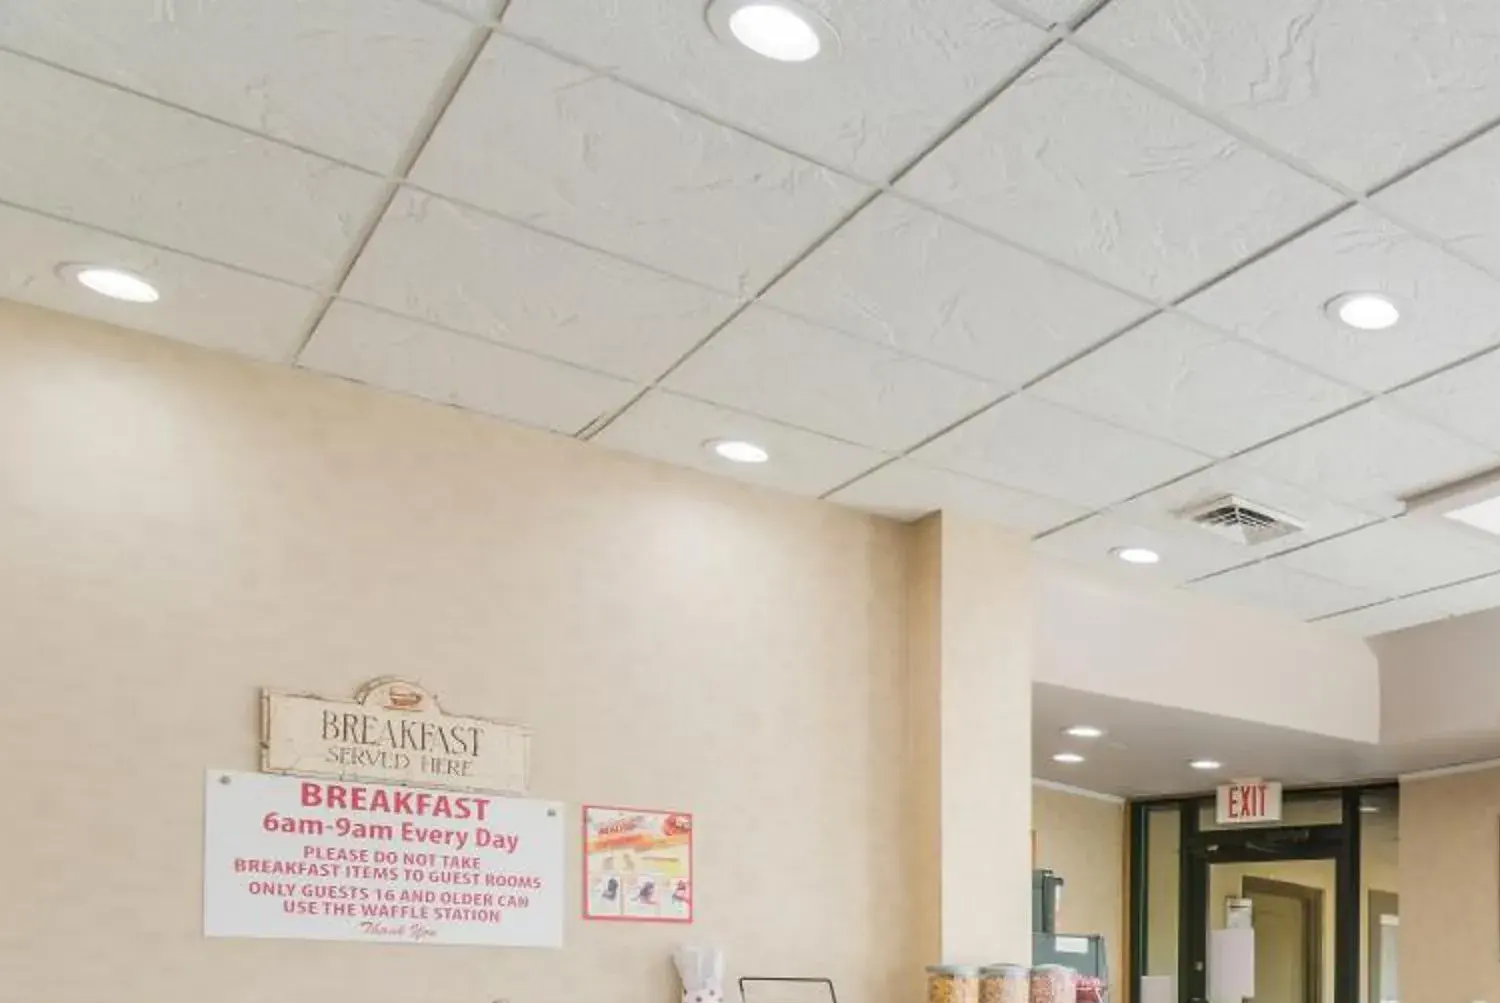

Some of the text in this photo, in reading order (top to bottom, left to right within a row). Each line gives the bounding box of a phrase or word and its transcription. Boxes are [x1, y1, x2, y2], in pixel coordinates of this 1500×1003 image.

[322, 709, 485, 757] BREAKFAST
[325, 747, 473, 777] SERVED HERE
[301, 782, 491, 821] BREAKFAST
[1228, 786, 1267, 818] EXIT
[263, 811, 519, 854] 6am-9am Every Day
[303, 846, 481, 870] PLEASE DO NOT TAKE
[234, 858, 542, 889] BREAKFAST ITEMS TO GUEST ROOMS
[248, 881, 529, 908] ONLY GUESTS 16 AND OLDER CAN
[283, 900, 501, 923] USE THE WAFFLE STATION
[360, 920, 437, 940] Thank You
